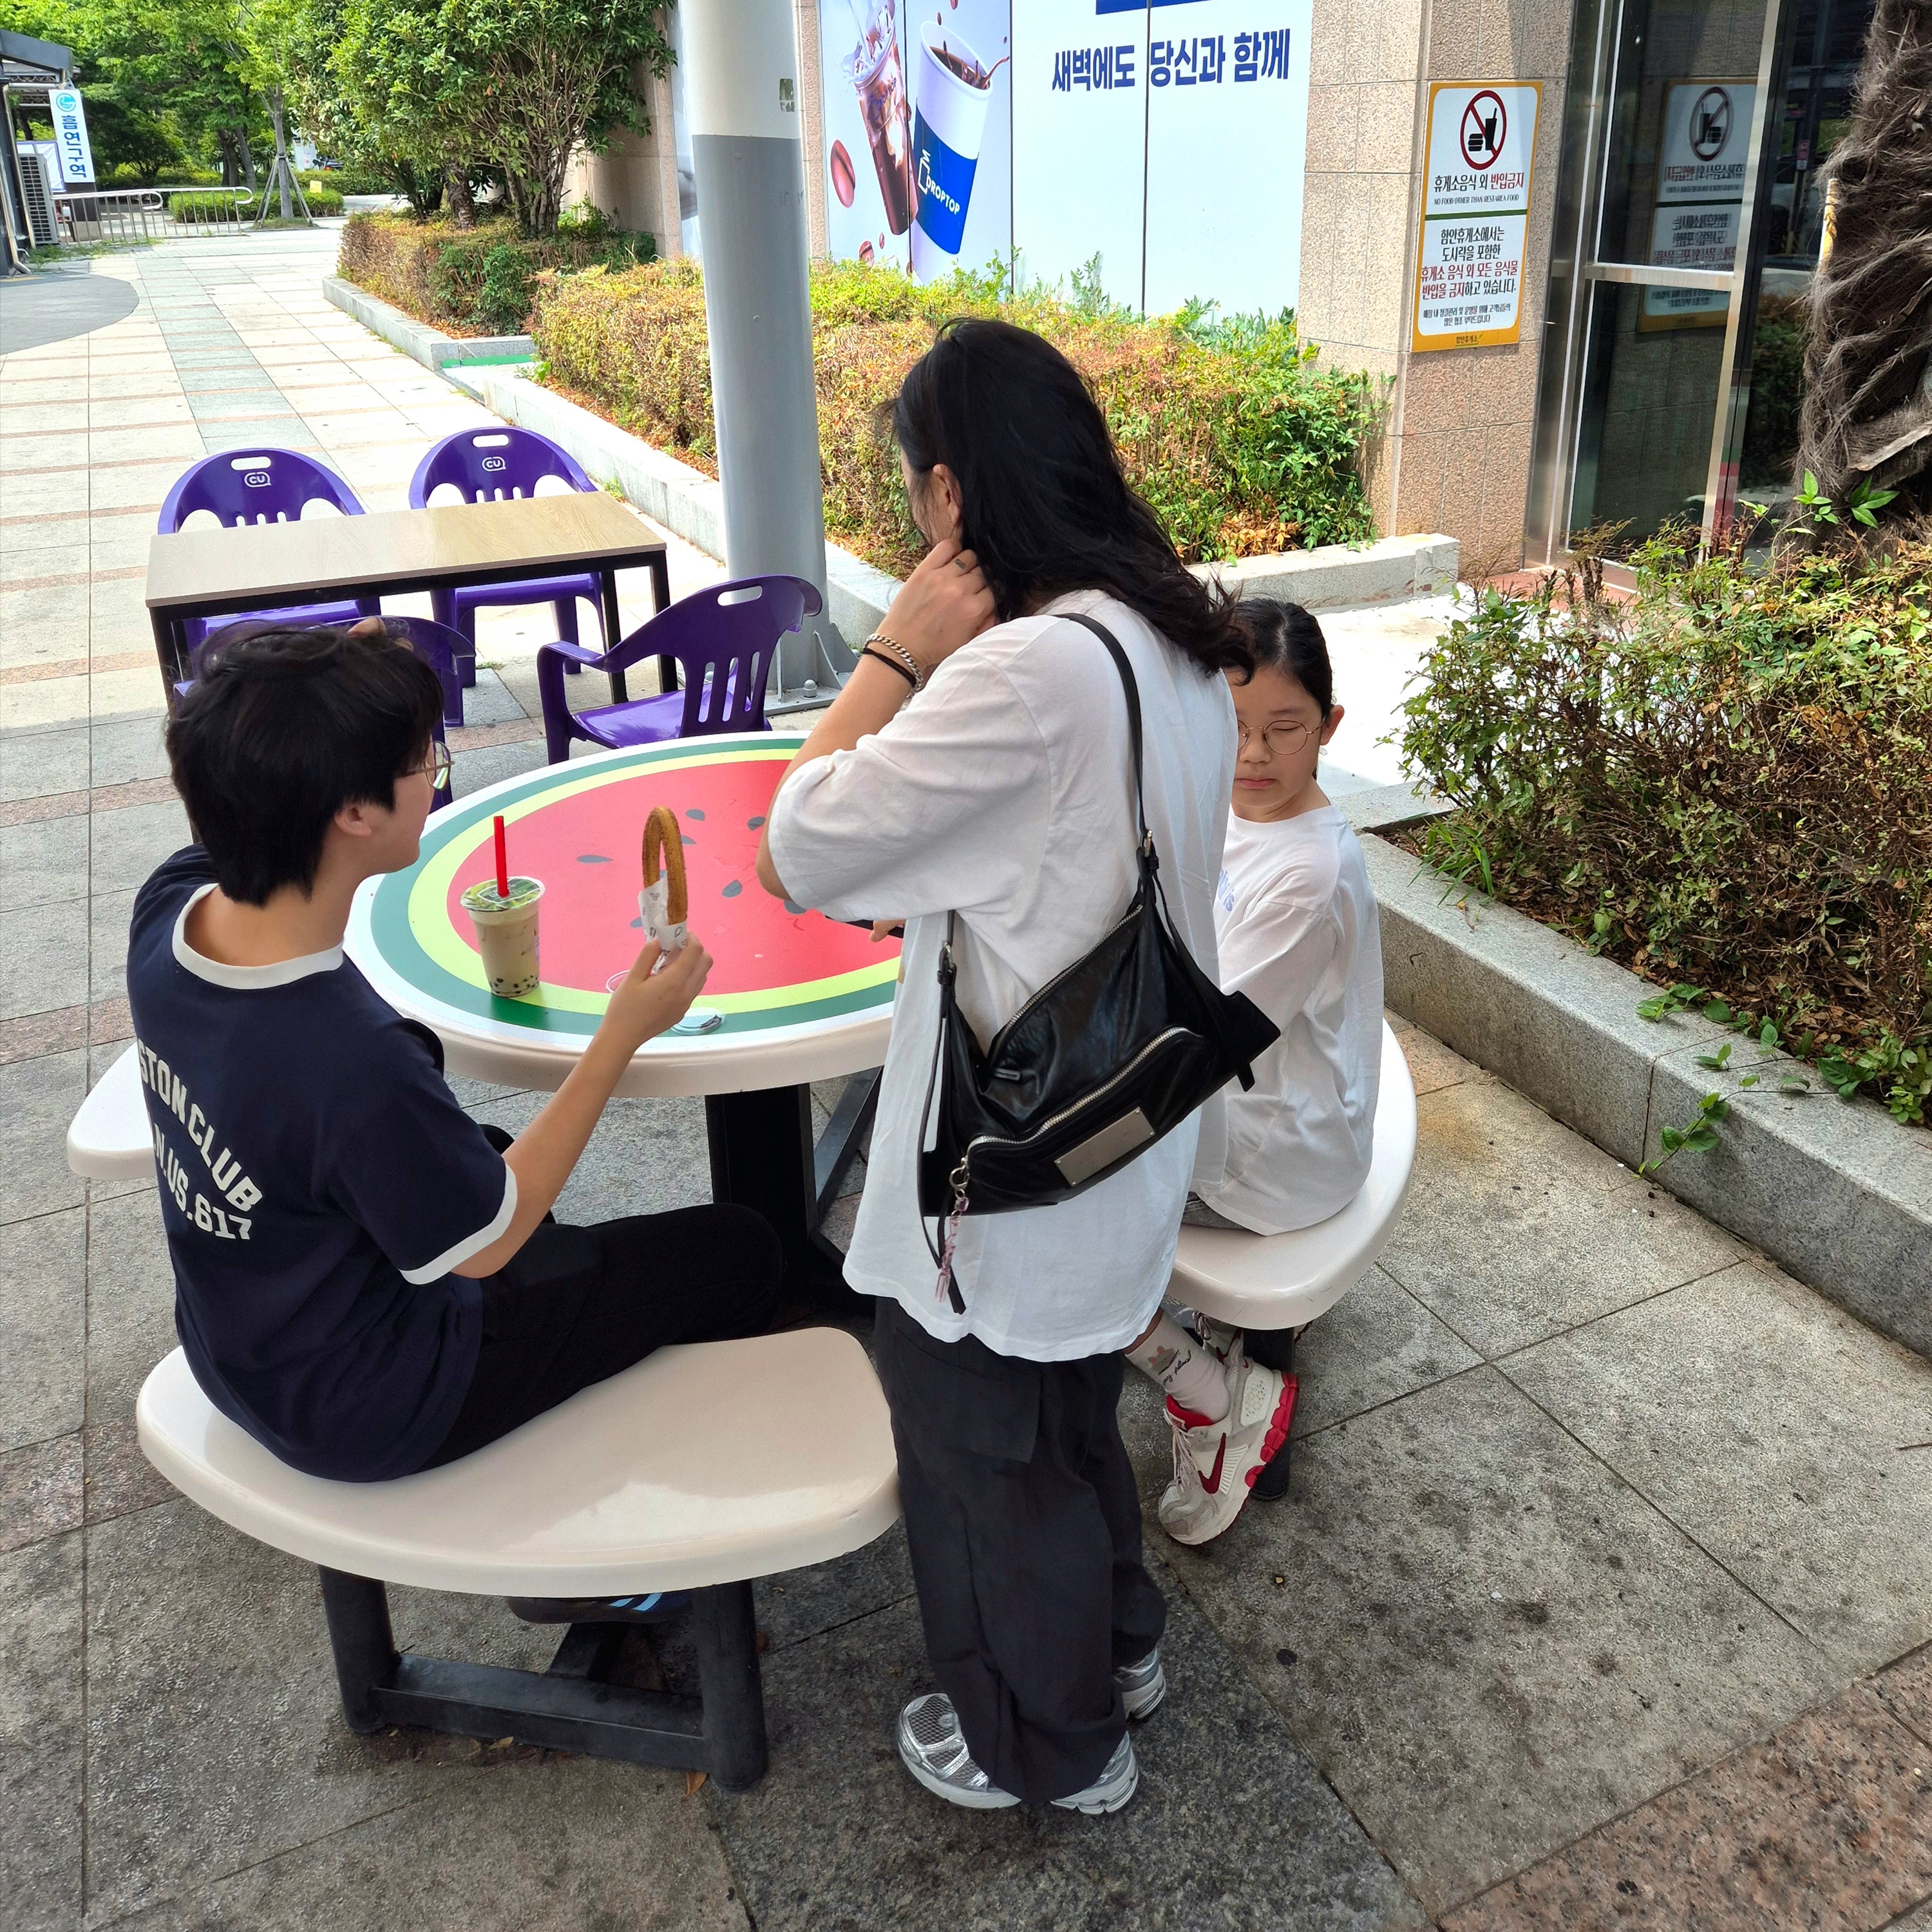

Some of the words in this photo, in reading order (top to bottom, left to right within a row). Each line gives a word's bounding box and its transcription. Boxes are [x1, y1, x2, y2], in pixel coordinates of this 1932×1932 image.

[1052, 44, 1135, 92] 새벽에도
[1150, 35, 1226, 87] 당신과
[1234, 28, 1291, 82] 함께
[61, 115, 87, 178] 흡연구역
[1434, 174, 1477, 193] 휴게소음식
[1479, 173, 1488, 190] 외
[1490, 172, 1524, 190] 반입금지
[925, 174, 960, 215] DROPTOP
[1441, 226, 1505, 245] 함안휴게소에서는
[1442, 245, 1474, 262] 도시락을
[1476, 243, 1501, 260] 포함한
[1421, 265, 1444, 282] 휴게소
[1448, 264, 1464, 280] 음식
[1466, 263, 1474, 278] 외
[1476, 262, 1492, 278] 모든
[1495, 260, 1518, 277] 음식물
[1423, 283, 1446, 300] 반입을
[1449, 281, 1481, 298] 금지하고
[1483, 278, 1516, 295] 있습니다.
[486, 460, 501, 468] CU
[249, 475, 265, 484] CU
[188, 1103, 263, 1212] CLUB
